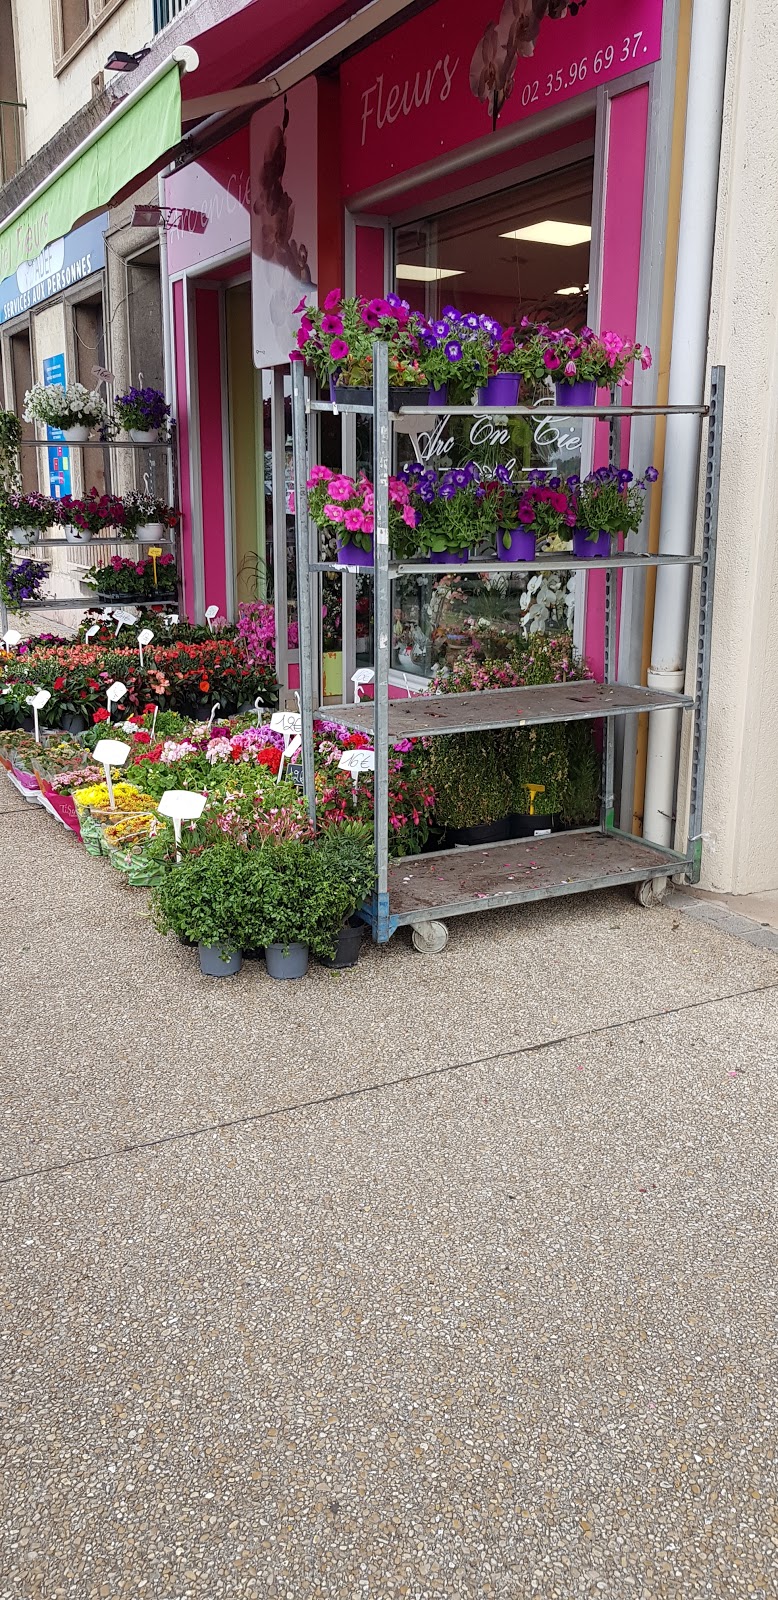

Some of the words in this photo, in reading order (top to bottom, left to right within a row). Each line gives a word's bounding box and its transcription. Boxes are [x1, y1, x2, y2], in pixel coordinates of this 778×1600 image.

[360, 53, 460, 147] Fleurs
[521, 80, 539, 106] 02
[544, 57, 588, 96] 35.96
[593, 45, 615, 74] 69
[226, 170, 251, 214] Cie
[3, 290, 31, 320] SERVICES
[32, 280, 46, 304] AUX
[47, 253, 92, 295] PERSONNES
[534, 398, 583, 452] Cie
